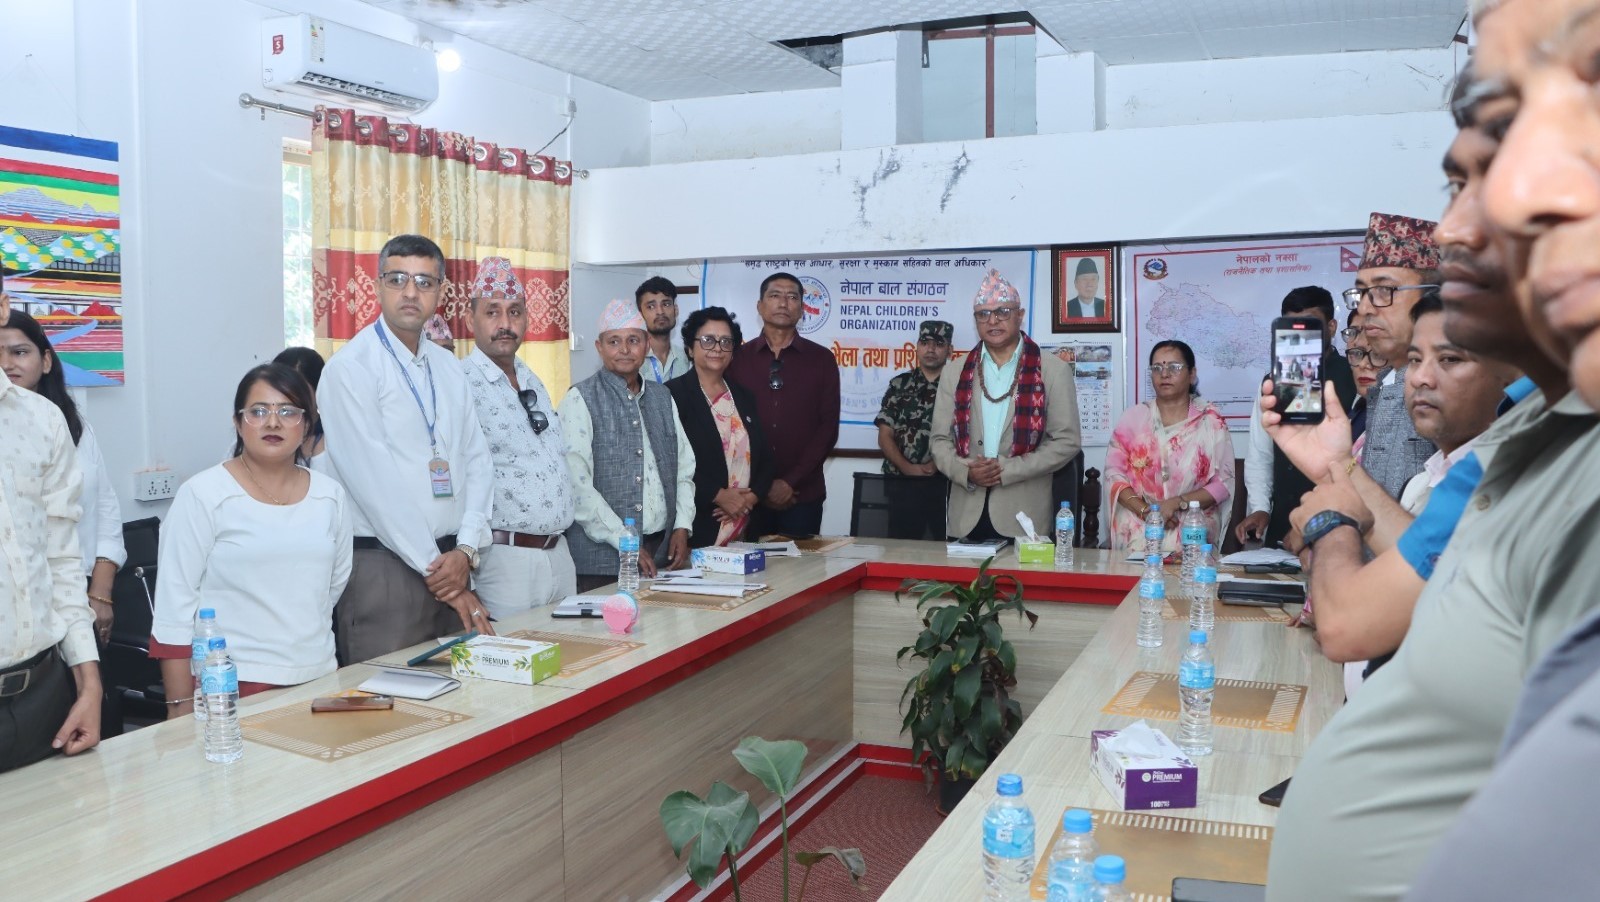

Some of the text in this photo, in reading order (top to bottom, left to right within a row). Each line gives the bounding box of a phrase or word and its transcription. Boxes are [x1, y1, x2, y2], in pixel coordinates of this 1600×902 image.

[863, 259, 870, 268] र
[1235, 252, 1271, 264] नेपालको
[840, 279, 874, 295] नेपाल
[878, 282, 902, 296] बाल
[907, 280, 949, 296] संगठन
[840, 305, 939, 317] NEPAL CHILDREN'S
[840, 319, 916, 331] ORGANIZATION
[863, 347, 889, 369] तथा
[482, 656, 510, 665] PREMIUM
[1152, 773, 1183, 781] PREMIUM
